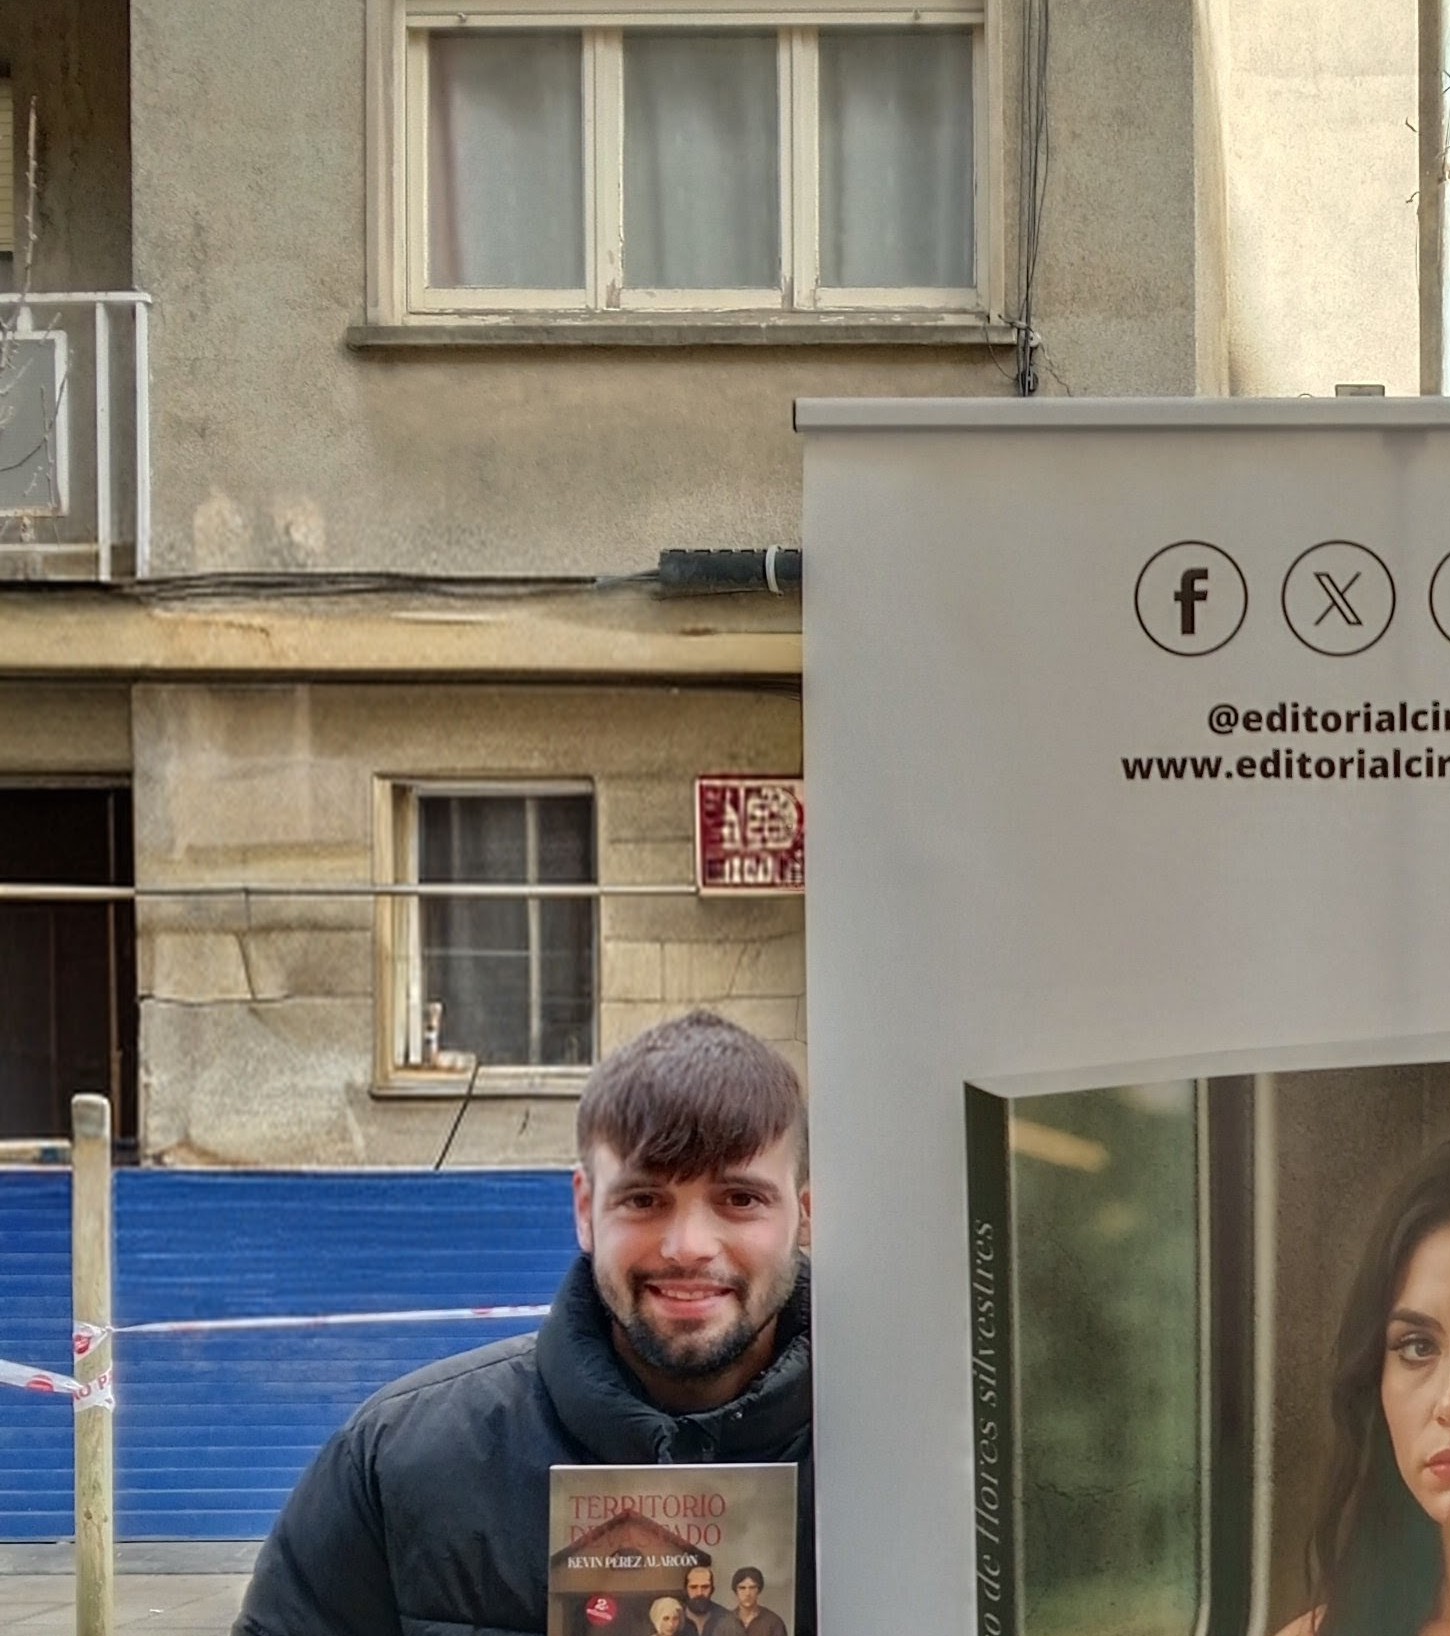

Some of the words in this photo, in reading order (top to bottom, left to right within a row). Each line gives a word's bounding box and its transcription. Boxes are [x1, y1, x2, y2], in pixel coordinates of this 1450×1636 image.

[972, 1219, 997, 1408] silvestres
[569, 1493, 725, 1519] TERRITORIO
[568, 1556, 604, 1568] KEVIN
[605, 1553, 642, 1569] PÉREZ
[644, 1552, 698, 1568] ALARCÓN
[977, 1555, 1001, 1601] de
